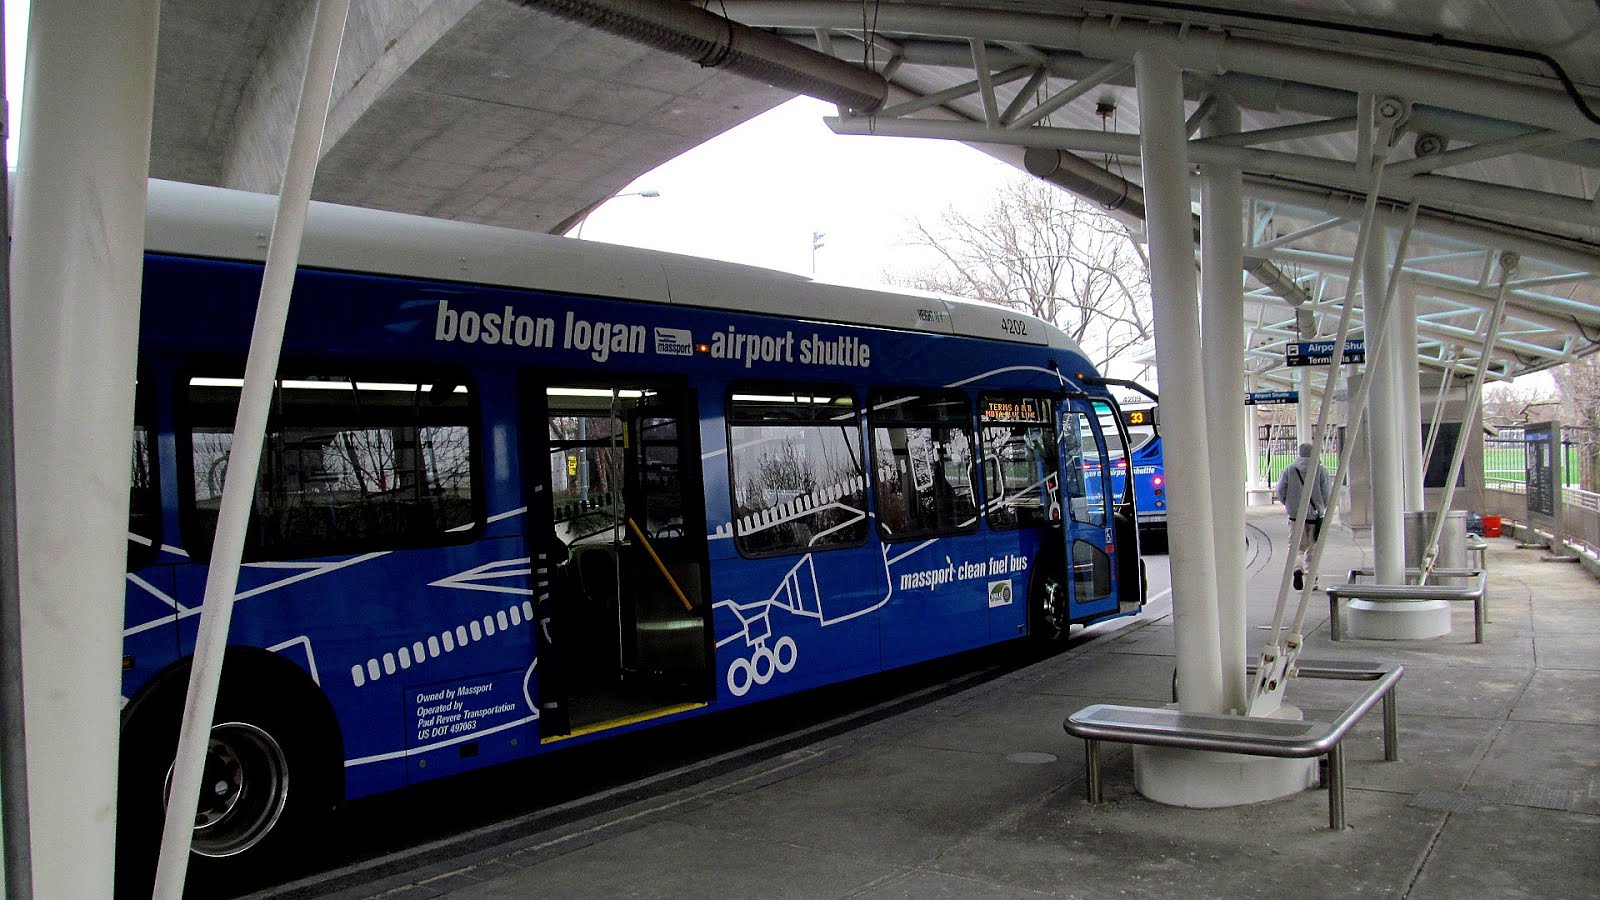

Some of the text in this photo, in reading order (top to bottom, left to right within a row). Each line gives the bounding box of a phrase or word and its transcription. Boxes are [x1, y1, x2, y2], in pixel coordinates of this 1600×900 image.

[435, 299, 646, 363] boston logan
[1001, 318, 1028, 336] 4202
[658, 342, 690, 354] massport
[711, 325, 870, 369] airport shuttle
[1308, 343, 1334, 354] Airpo
[1308, 355, 1350, 365] Termils
[989, 402, 1012, 412] TERMS
[1131, 412, 1143, 424] 33
[901, 554, 1028, 591] massport clean fuel bus
[416, 683, 492, 703] Owned by Massport
[416, 701, 463, 717] Operated by
[417, 702, 516, 728] Paul Revere Transportation
[417, 720, 477, 740] US DOT 497063
